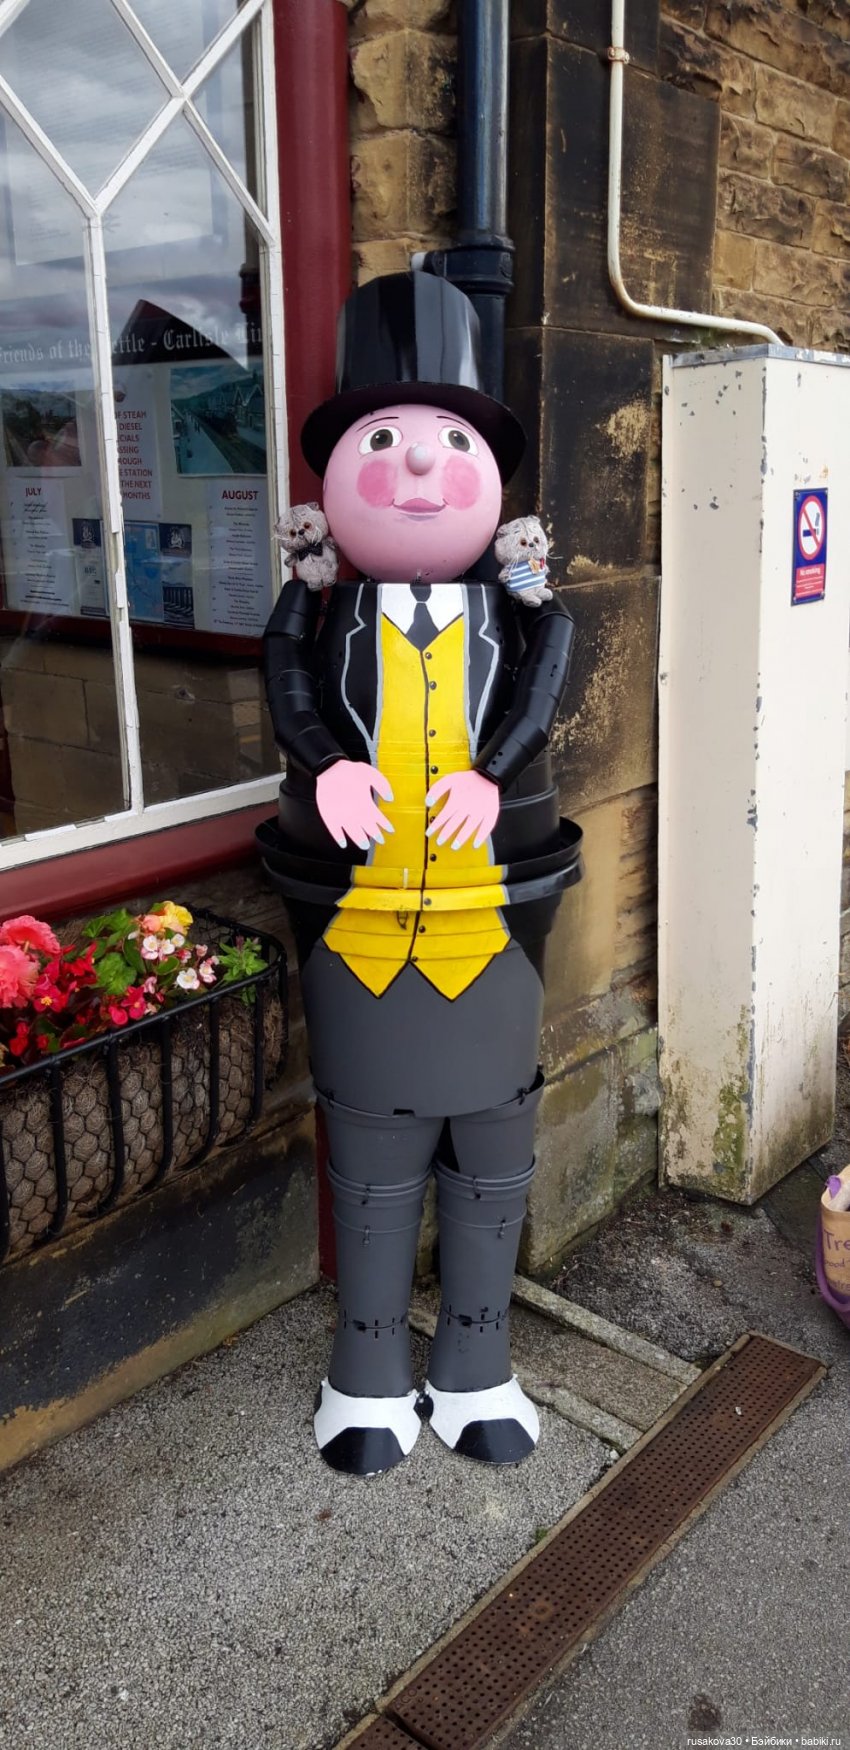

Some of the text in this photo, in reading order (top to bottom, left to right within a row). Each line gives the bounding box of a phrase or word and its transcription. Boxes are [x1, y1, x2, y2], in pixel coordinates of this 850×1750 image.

[0, 342, 43, 362] riends
[112, 332, 145, 354] ettle
[163, 325, 226, 350] Carlisle
[123, 410, 146, 419] STEAM
[119, 422, 143, 431] DIESEL
[118, 434, 140, 442] CIALS
[118, 446, 139, 454] SSING
[118, 457, 142, 466] ROUGH
[125, 468, 153, 477] STATION
[121, 480, 152, 489] THE NEXT
[25, 487, 42, 497] JULY
[221, 489, 259, 501] AUGUST
